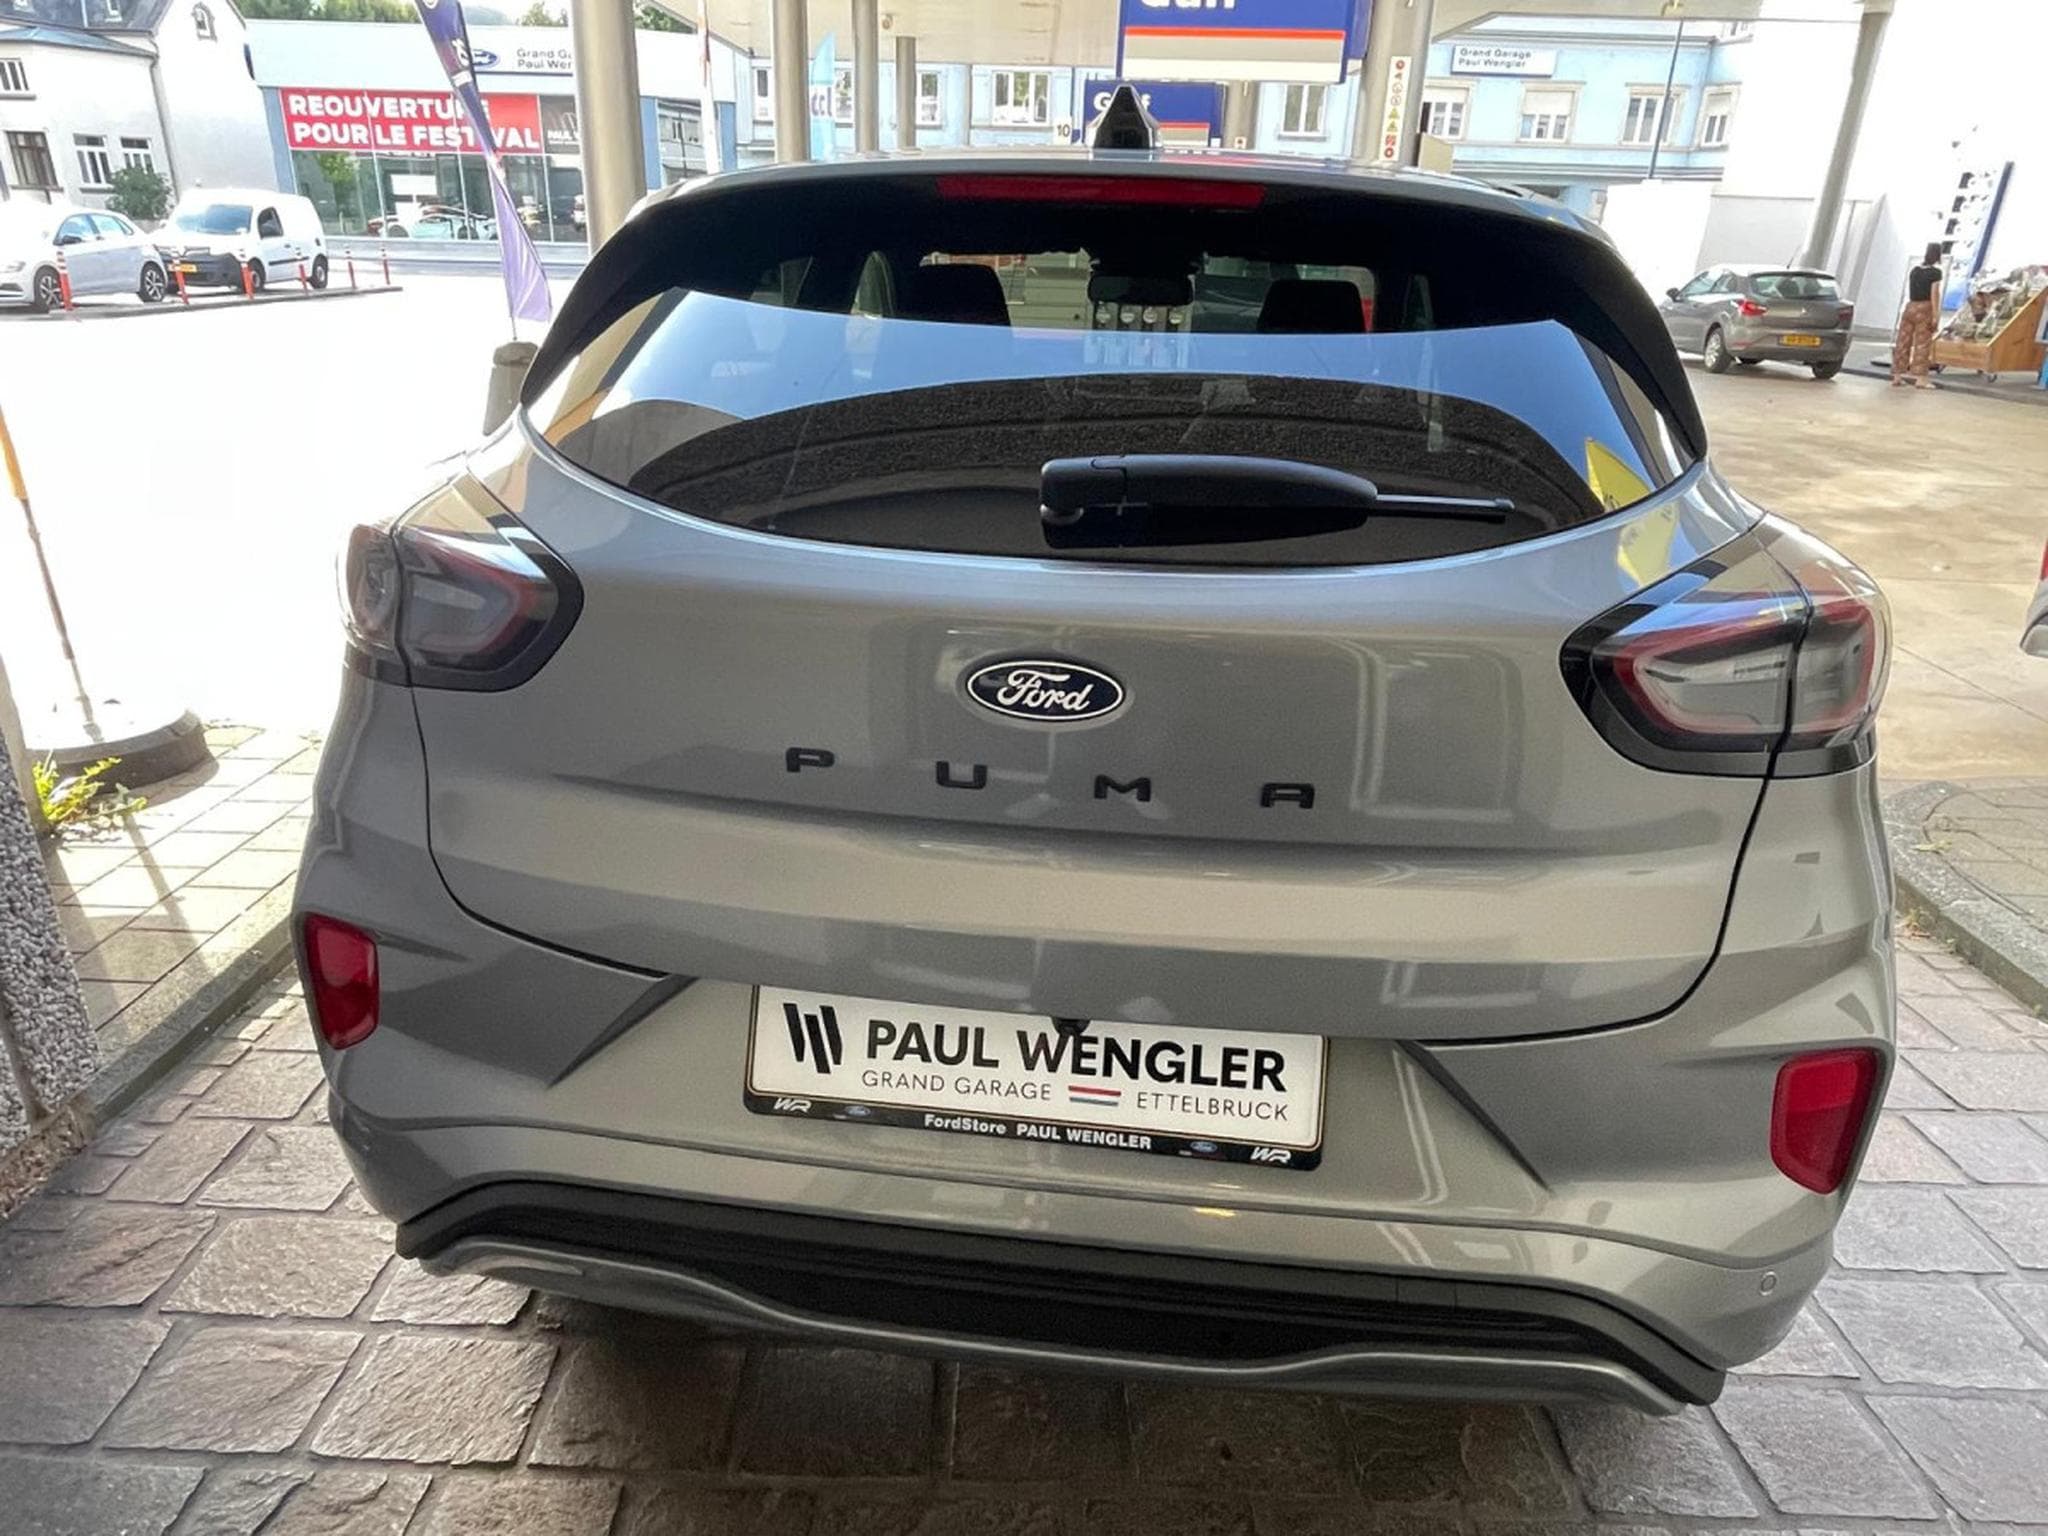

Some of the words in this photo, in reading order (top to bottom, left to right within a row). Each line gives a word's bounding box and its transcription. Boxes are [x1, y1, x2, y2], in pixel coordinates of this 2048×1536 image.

[287, 94, 490, 121] REOUVERTU
[1093, 91, 1152, 112] Gf
[292, 122, 369, 143] POUR
[375, 124, 408, 146] LE
[413, 125, 541, 149] FESTVAL
[1056, 123, 1071, 137] 10
[997, 668, 1094, 712] Ford
[785, 746, 1316, 810] PUMA
[866, 1019, 999, 1069] PAUL
[1016, 1029, 1287, 1092] WENGLER
[862, 1069, 945, 1092] GRAND
[954, 1076, 1051, 1100] GARAGE
[1137, 1091, 1289, 1121] ETTELBRUCK
[924, 1113, 1007, 1135] FordStore
[1016, 1122, 1061, 1141] PAUL
[1066, 1127, 1151, 1150] WENGLER
